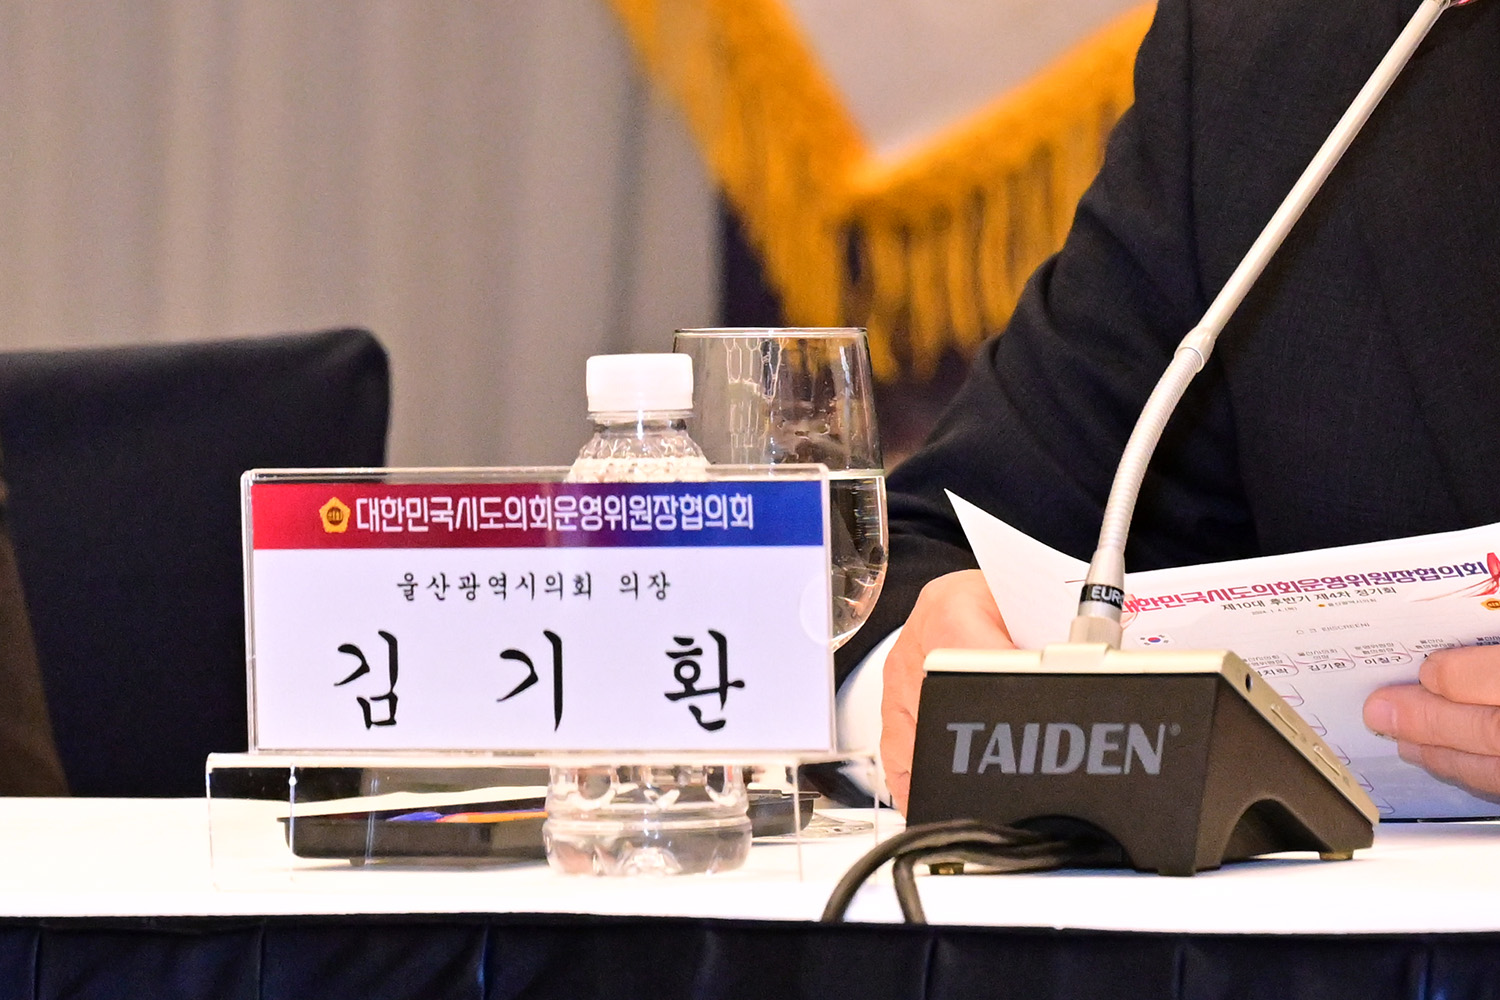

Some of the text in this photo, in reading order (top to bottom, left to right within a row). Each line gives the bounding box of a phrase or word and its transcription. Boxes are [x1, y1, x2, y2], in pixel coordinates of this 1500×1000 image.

[355, 493, 755, 532] 대한민국시도의회운영위원장협의회
[397, 572, 671, 601] 울산광역시의회 의장
[1222, 585, 1397, 611] 제10대 후반기 제4차 정기회
[946, 722, 1166, 775] TAIDEN
